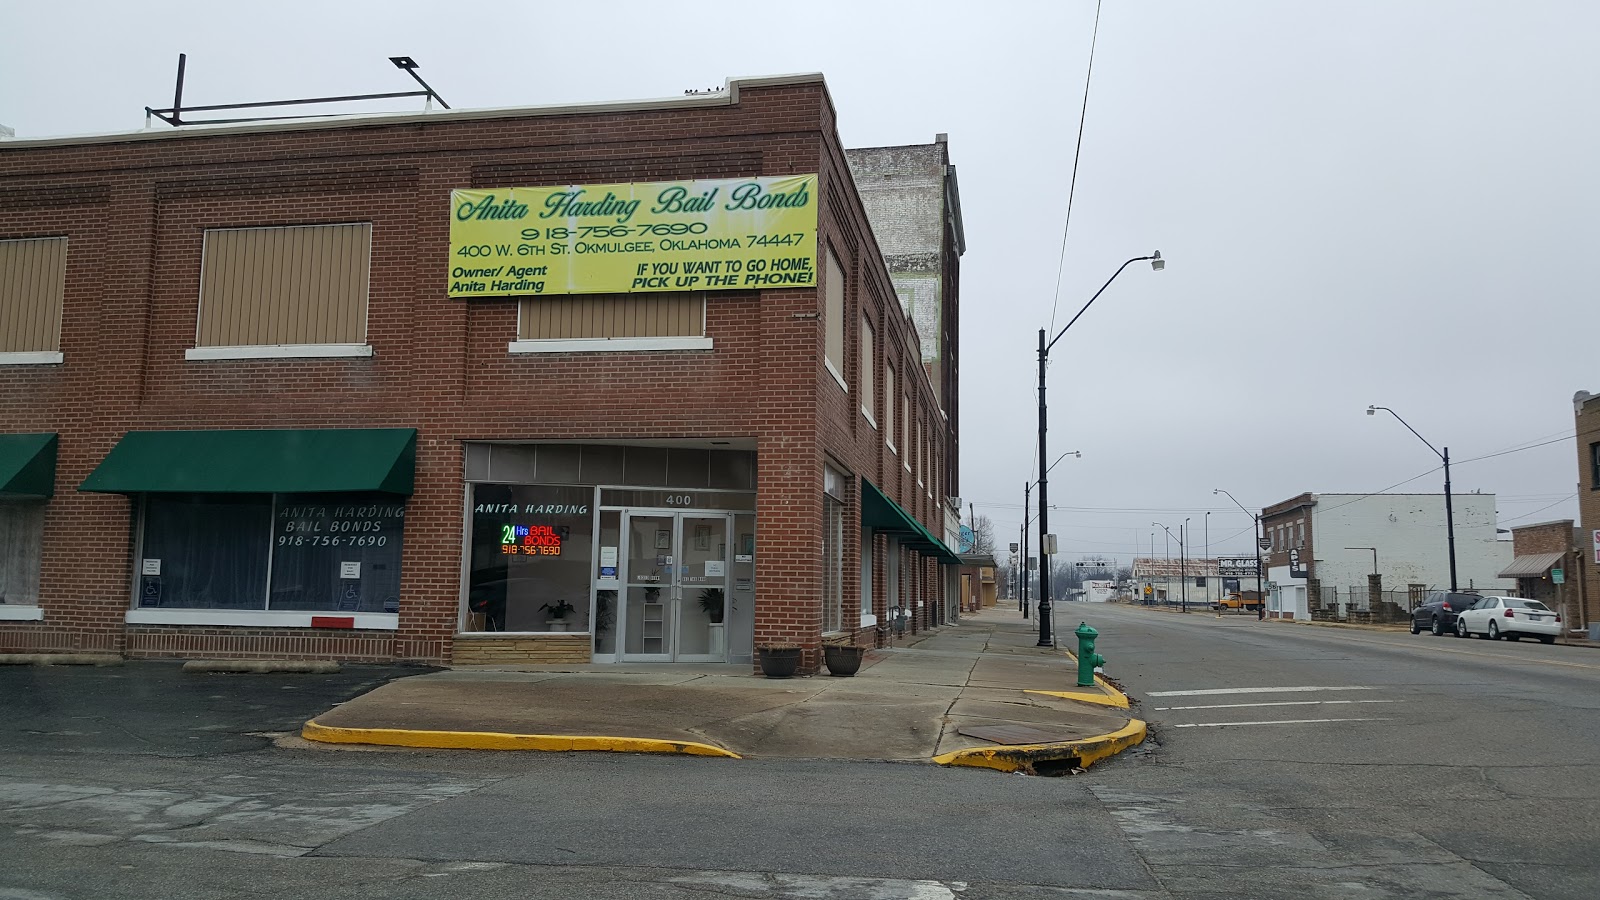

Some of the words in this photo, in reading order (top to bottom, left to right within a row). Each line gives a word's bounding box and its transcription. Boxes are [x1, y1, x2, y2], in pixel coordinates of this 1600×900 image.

[457, 194, 529, 222] Anita
[539, 189, 641, 223] Harding
[651, 186, 719, 214] Bail
[725, 181, 809, 211] Bonds
[521, 222, 708, 241] 918-756-7690
[457, 245, 491, 257] 400
[496, 244, 513, 256] W.
[517, 243, 545, 256] 6TH
[659, 238, 741, 251] OKLAHOMA
[746, 233, 804, 247] 74447
[452, 265, 504, 278] Owner/
[506, 265, 548, 279] Agent
[637, 263, 648, 275] IF
[652, 262, 679, 275] YOU
[683, 261, 722, 274] WANT
[725, 260, 742, 273] TO
[747, 259, 766, 272] GO
[770, 257, 812, 273] HOME,
[450, 280, 486, 292] Anita
[490, 279, 545, 293] Harding
[632, 276, 670, 288] PICK
[675, 275, 699, 287] UP
[705, 274, 739, 286] THE
[744, 272, 813, 285] PHONE!
[666, 495, 691, 505] 400
[280, 507, 326, 518] ANITA
[334, 506, 405, 518] HARDING
[475, 503, 518, 514] ANITA
[525, 504, 588, 514] HARDING
[286, 521, 321, 532] BAIL
[330, 521, 382, 532] BONDS
[278, 535, 387, 547] 918-756-7690
[502, 525, 516, 544] 24
[516, 526, 529, 536] Hrs
[530, 525, 556, 536] BAIL
[524, 536, 561, 546] BONDS
[502, 545, 561, 555] 918-756-7690
[1220, 559, 1235, 567] MR.
[1237, 559, 1258, 567] GLASS
[1290, 549, 1299, 572] APTS
